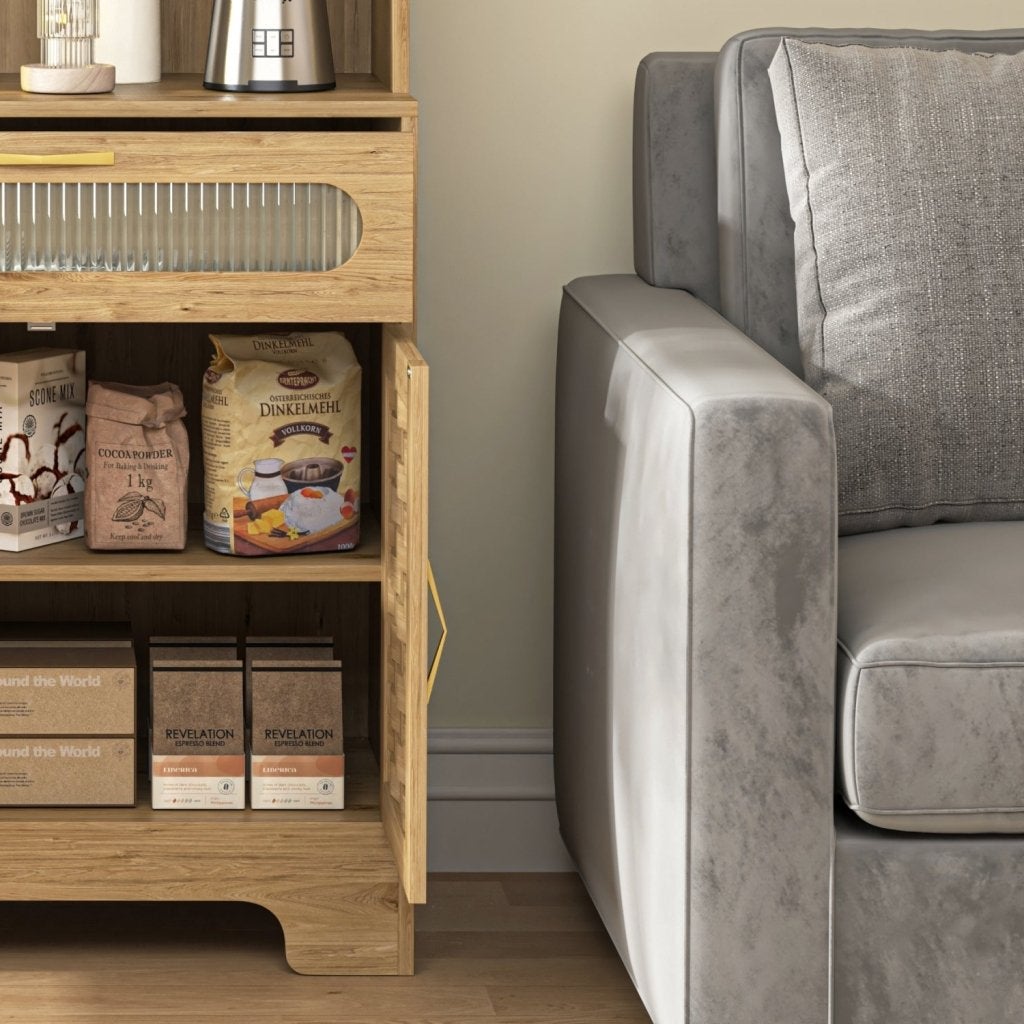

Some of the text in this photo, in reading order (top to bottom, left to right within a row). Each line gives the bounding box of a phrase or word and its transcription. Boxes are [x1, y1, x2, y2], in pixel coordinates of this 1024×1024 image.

[252, 337, 314, 351] DINKELMEHL
[29, 383, 75, 407] SCONE MIX
[269, 392, 332, 401] ÖSTERREICHISCHES
[260, 400, 341, 417] DINKELMEHL
[281, 425, 322, 436] VOLLKORN
[98, 448, 173, 459] COCOA POWDER
[116, 463, 136, 471] Baking
[128, 474, 153, 492] 1 kg
[110, 533, 126, 541] Keep
[33, 675, 56, 687] the
[60, 675, 101, 687] World
[165, 729, 234, 739] REVELATION
[264, 729, 333, 739] REVELATION
[33, 745, 56, 758] the
[60, 745, 101, 758] World
